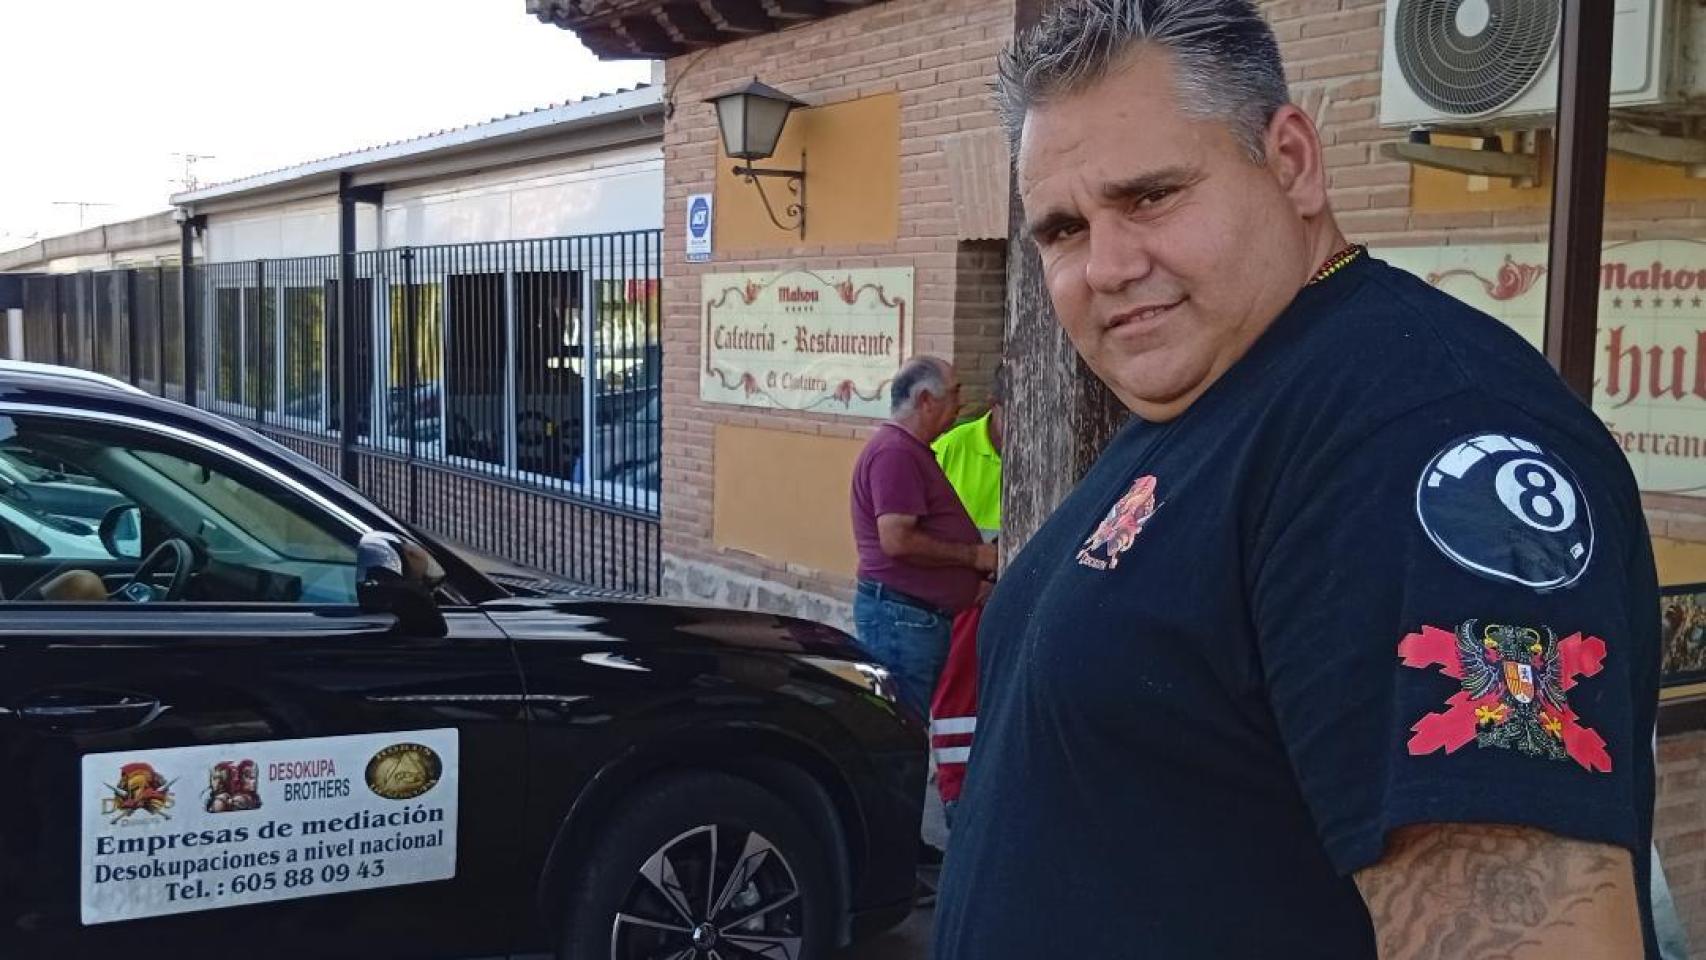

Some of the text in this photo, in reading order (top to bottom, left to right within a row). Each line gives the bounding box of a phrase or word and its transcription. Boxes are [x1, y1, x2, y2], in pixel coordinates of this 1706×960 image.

[795, 325, 894, 356] Restaurante
[269, 759, 336, 781] DESOKUPA
[284, 778, 350, 801] BROTHERS
[96, 804, 444, 856] Empresas de mediación
[95, 829, 443, 884] Desokupaciones a nivel nacional
[231, 871, 277, 895] 605
[284, 867, 314, 888] 88
[321, 863, 350, 883] 09
[357, 859, 385, 879] 43
